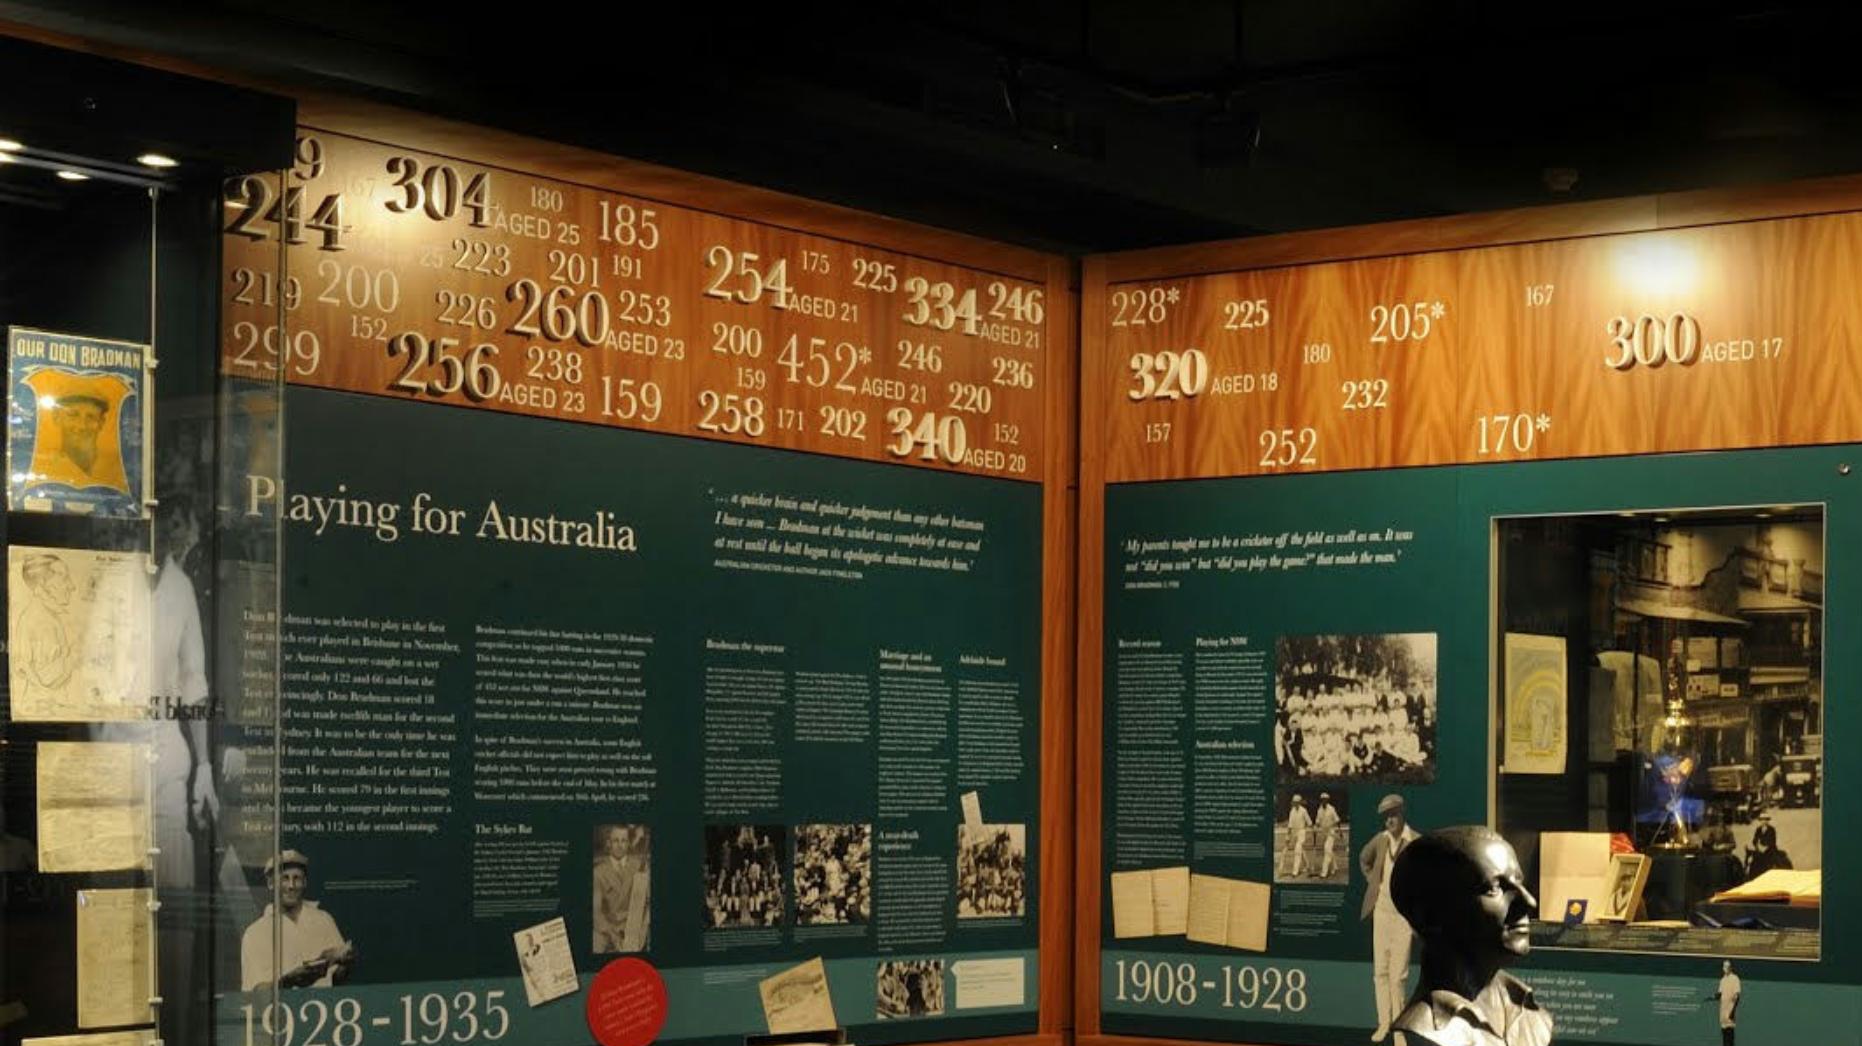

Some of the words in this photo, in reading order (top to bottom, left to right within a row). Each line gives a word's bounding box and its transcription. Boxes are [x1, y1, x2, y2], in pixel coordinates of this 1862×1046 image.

[224, 173, 351, 251] 244
[384, 155, 499, 229] 304
[494, 213, 551, 239] AGED
[557, 221, 581, 245] 25
[529, 185, 564, 213] 180
[598, 199, 660, 251] 185
[451, 237, 512, 278] 223
[548, 249, 600, 288] 201
[612, 254, 643, 279] 191
[801, 249, 830, 275] 175
[851, 257, 898, 294] 225
[317, 259, 400, 314] 200
[702, 245, 793, 309] 254
[786, 295, 836, 321] AGED
[840, 301, 859, 323] 21
[1524, 284, 1555, 308] 167
[434, 289, 497, 330] 226
[505, 277, 610, 348] 260
[604, 330, 656, 356] AGED
[662, 337, 685, 360] 23
[618, 289, 672, 327] 253
[901, 276, 982, 336] 334
[979, 322, 1021, 347] AGED
[1025, 329, 1041, 349] 21
[987, 281, 1044, 326] 246
[1223, 298, 1270, 331] 225
[350, 314, 388, 342] 152
[711, 320, 763, 358] 200
[1603, 311, 1700, 372] 300
[1701, 340, 1754, 363] AGED
[1760, 336, 1784, 360] 17
[16, 338, 46, 358] OUR
[49, 344, 77, 366] DON
[80, 348, 142, 370] BRADMAN
[386, 330, 501, 402] 256
[499, 384, 558, 410] AGED
[562, 391, 586, 414] 23
[526, 345, 583, 384] 238
[897, 339, 943, 374] 246
[1302, 342, 1331, 365] 180
[735, 366, 766, 392] 159
[860, 377, 906, 402] AGED
[909, 384, 928, 405] 21
[991, 356, 1034, 390] 236
[1127, 348, 1208, 402] 320
[1209, 375, 1255, 396] AGED
[1259, 371, 1279, 392] 18
[600, 375, 663, 423] 159
[947, 380, 993, 416] 220
[1341, 378, 1389, 410] 232
[697, 389, 766, 438] 258
[776, 407, 804, 432] 171
[819, 404, 867, 442] 202
[885, 406, 967, 465] 340
[962, 447, 1005, 470] AGED
[1008, 453, 1027, 474] 20
[994, 422, 1020, 446] 152
[1144, 422, 1172, 444] 157
[1258, 427, 1318, 468] 252
[246, 475, 400, 541] Playing
[411, 493, 466, 536] for
[475, 499, 638, 552] Australia
[1114, 959, 1308, 1014] 1908-1928
